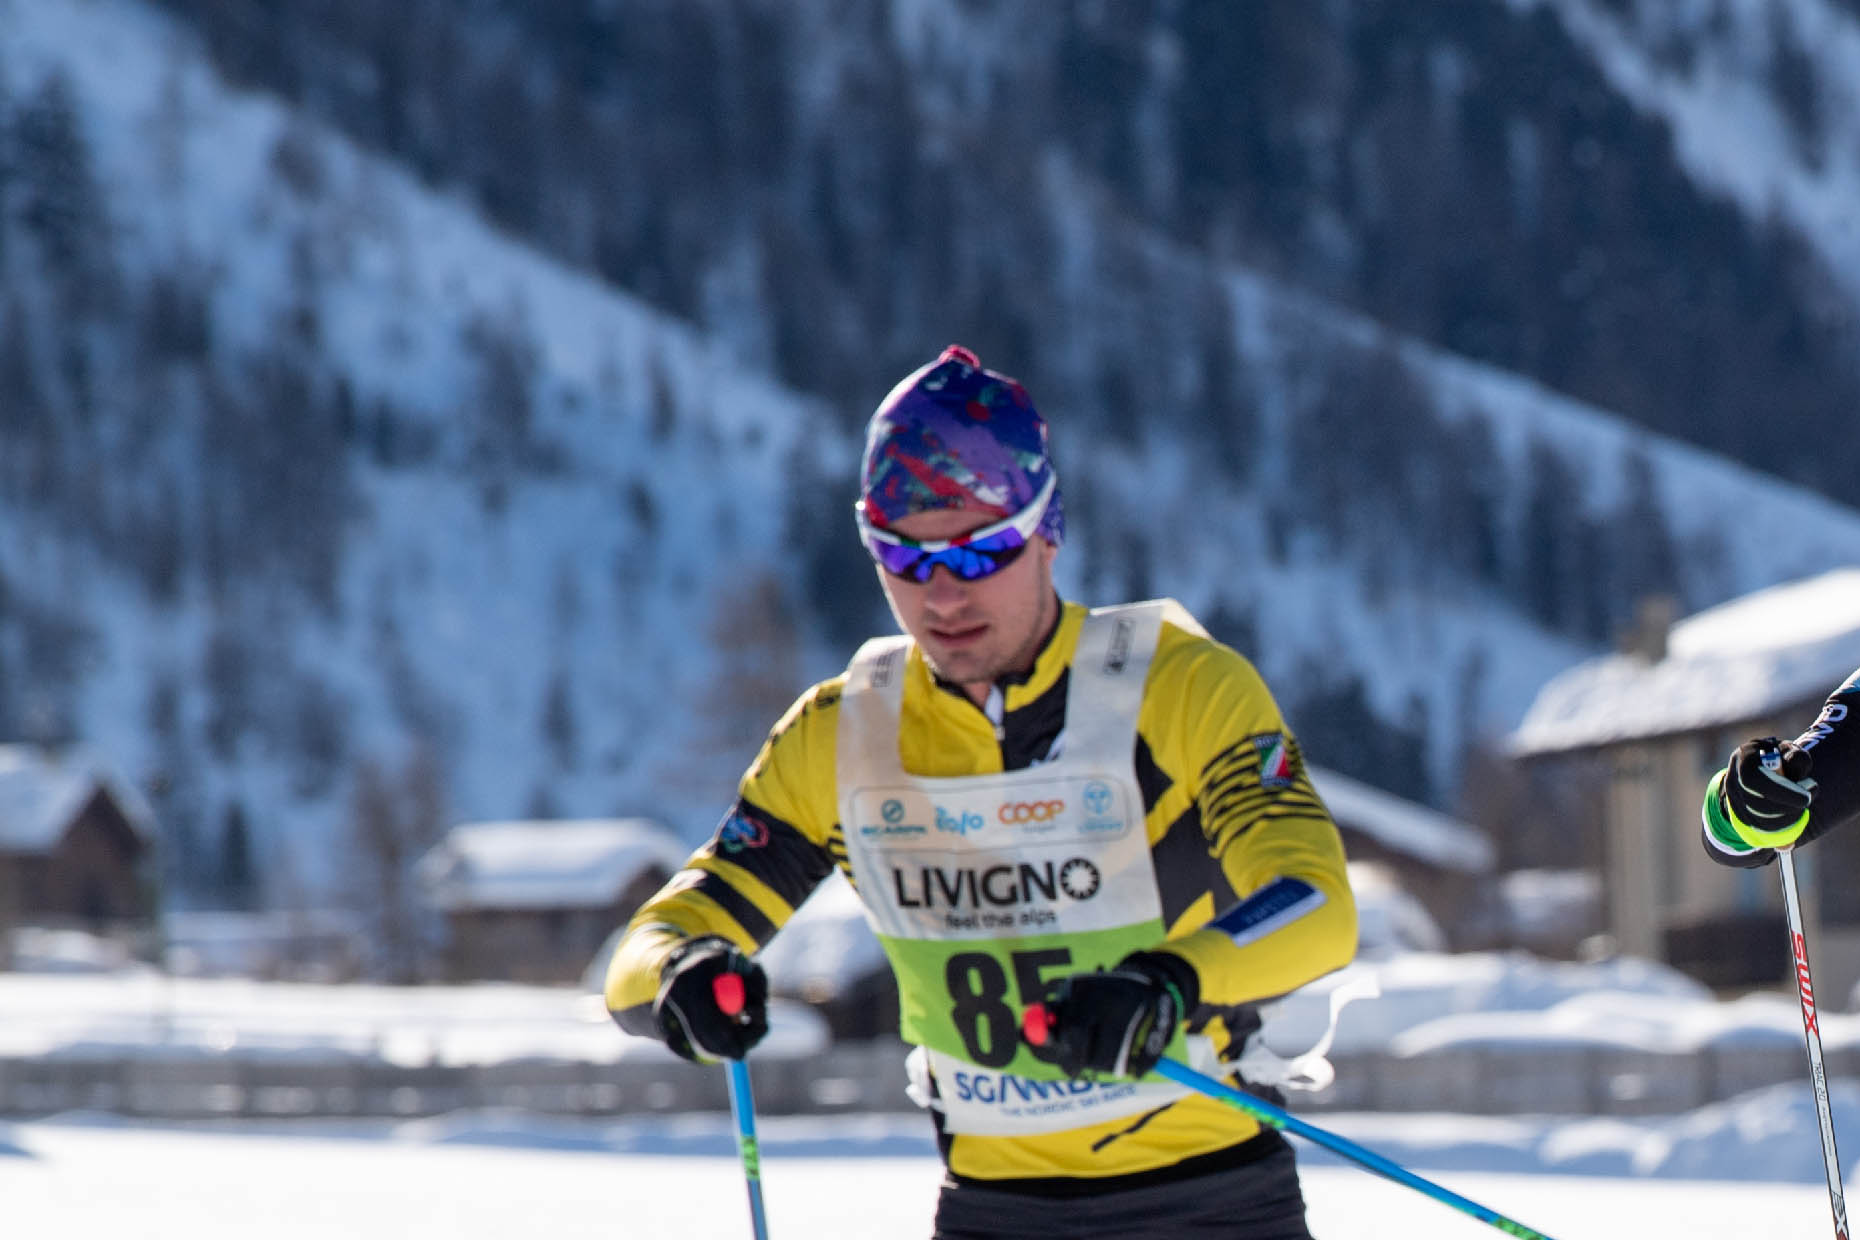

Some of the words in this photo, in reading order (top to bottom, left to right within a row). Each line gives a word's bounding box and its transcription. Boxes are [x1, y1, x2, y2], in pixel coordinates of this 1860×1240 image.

[894, 857, 1101, 908] LIVIGNO
[946, 912, 979, 929] feel
[983, 910, 1014, 927] the
[1020, 908, 1056, 926] alps
